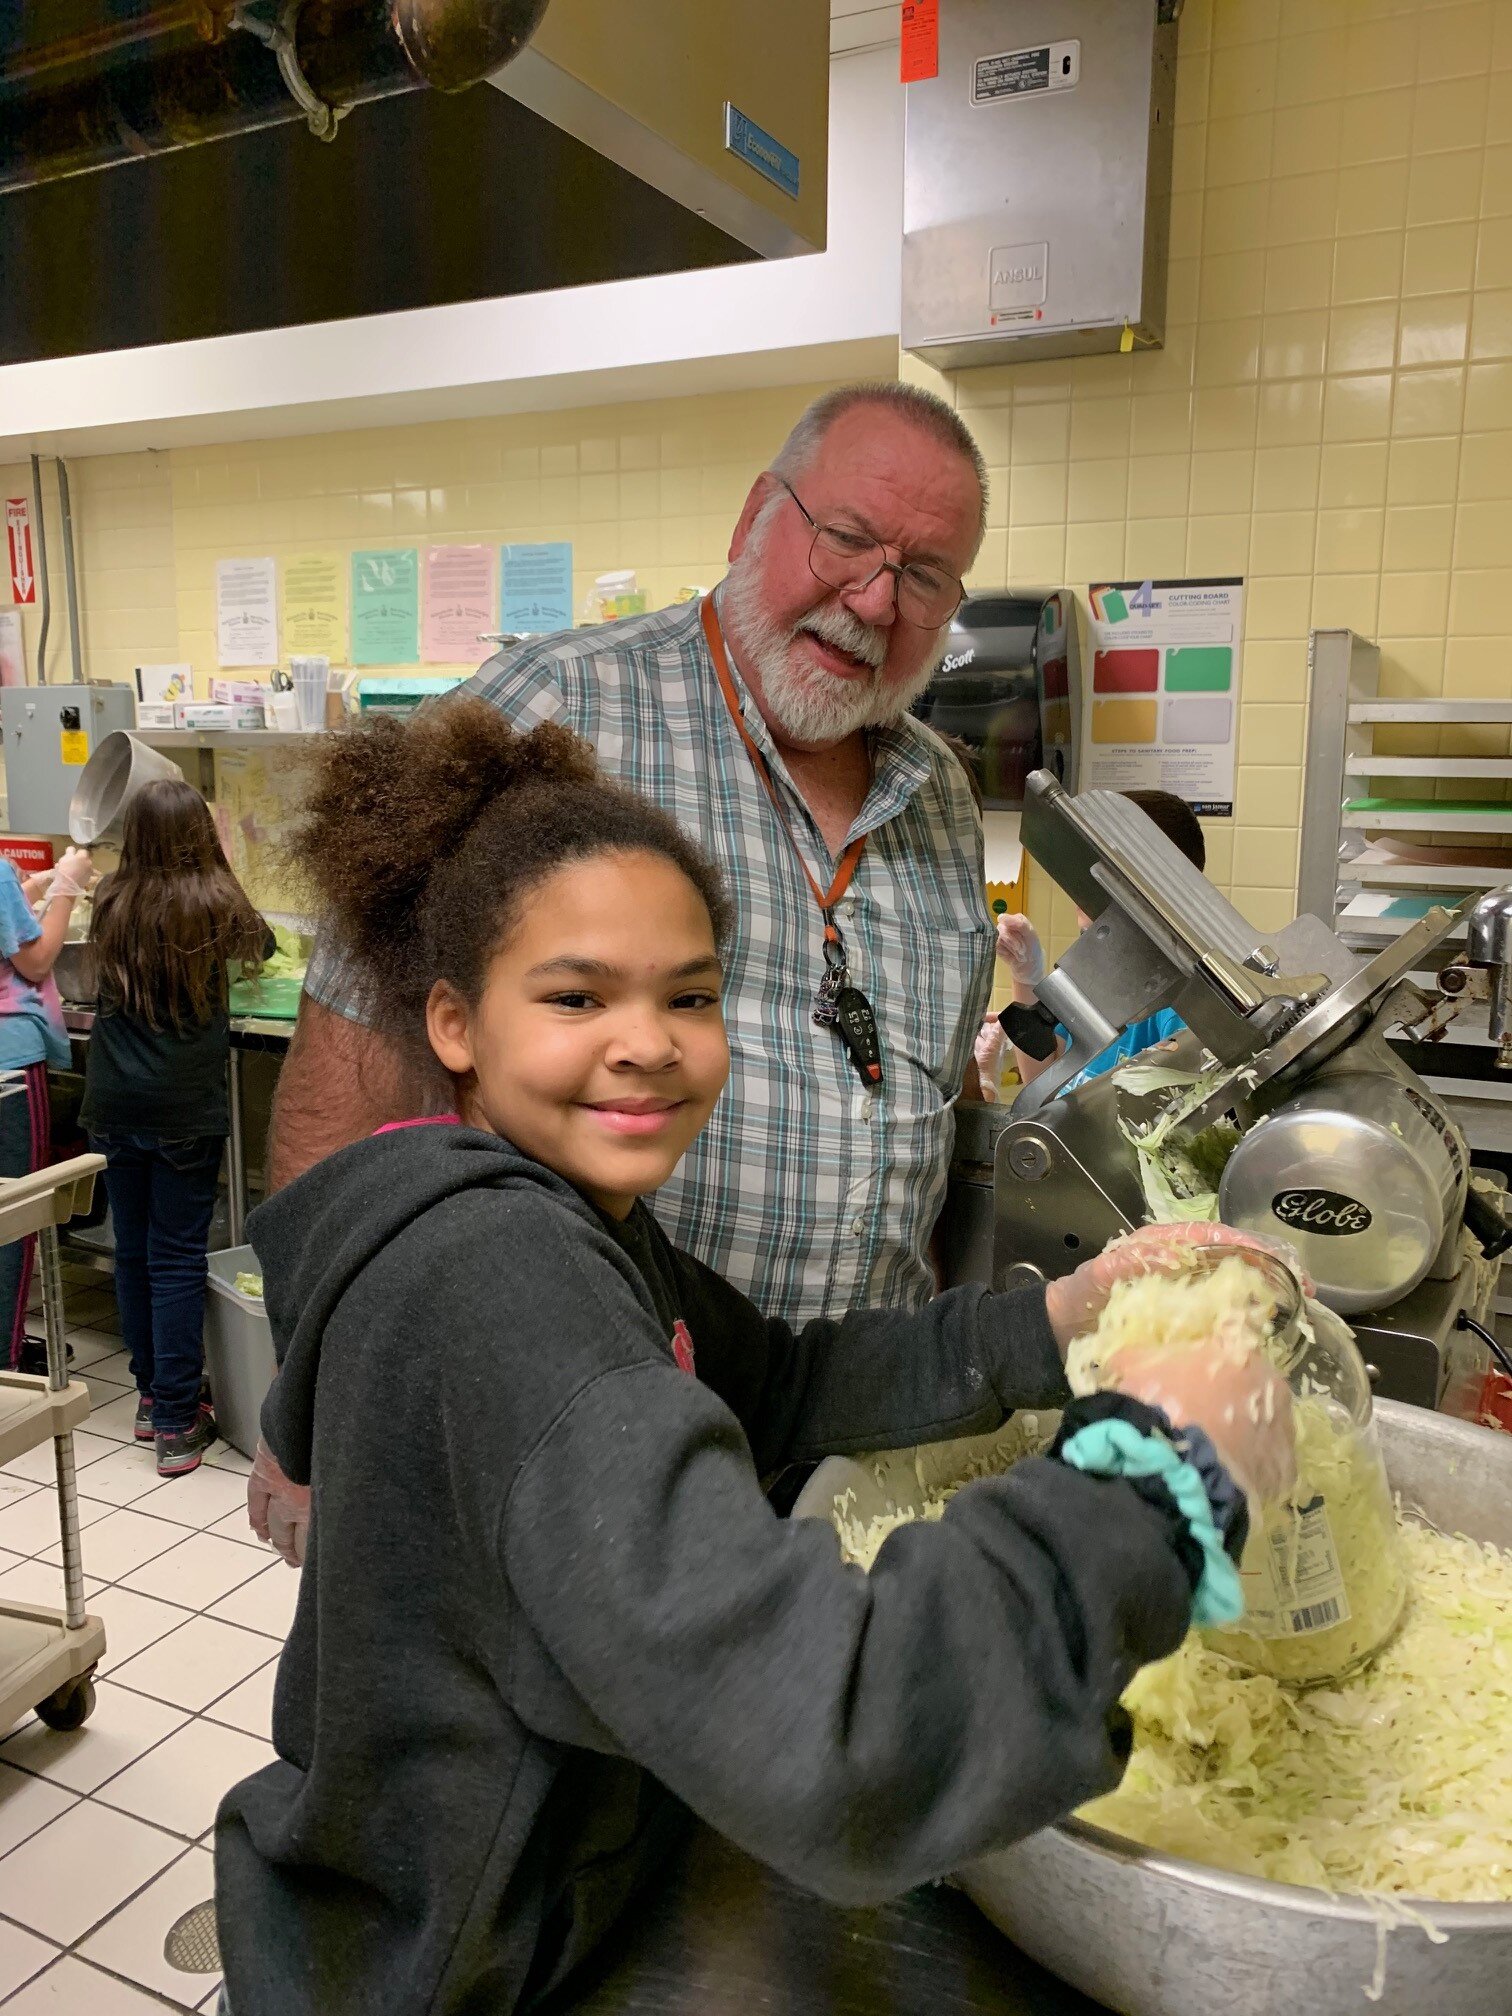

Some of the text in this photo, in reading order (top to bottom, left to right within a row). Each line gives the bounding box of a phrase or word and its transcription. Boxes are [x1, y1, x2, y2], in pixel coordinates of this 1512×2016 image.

[993, 267, 1042, 285] ANSUL
[8, 508, 26, 517] FIRE
[1203, 592, 1229, 600] BOARD
[942, 648, 974, 672] Scott
[4, 848, 45, 860] CAUTION
